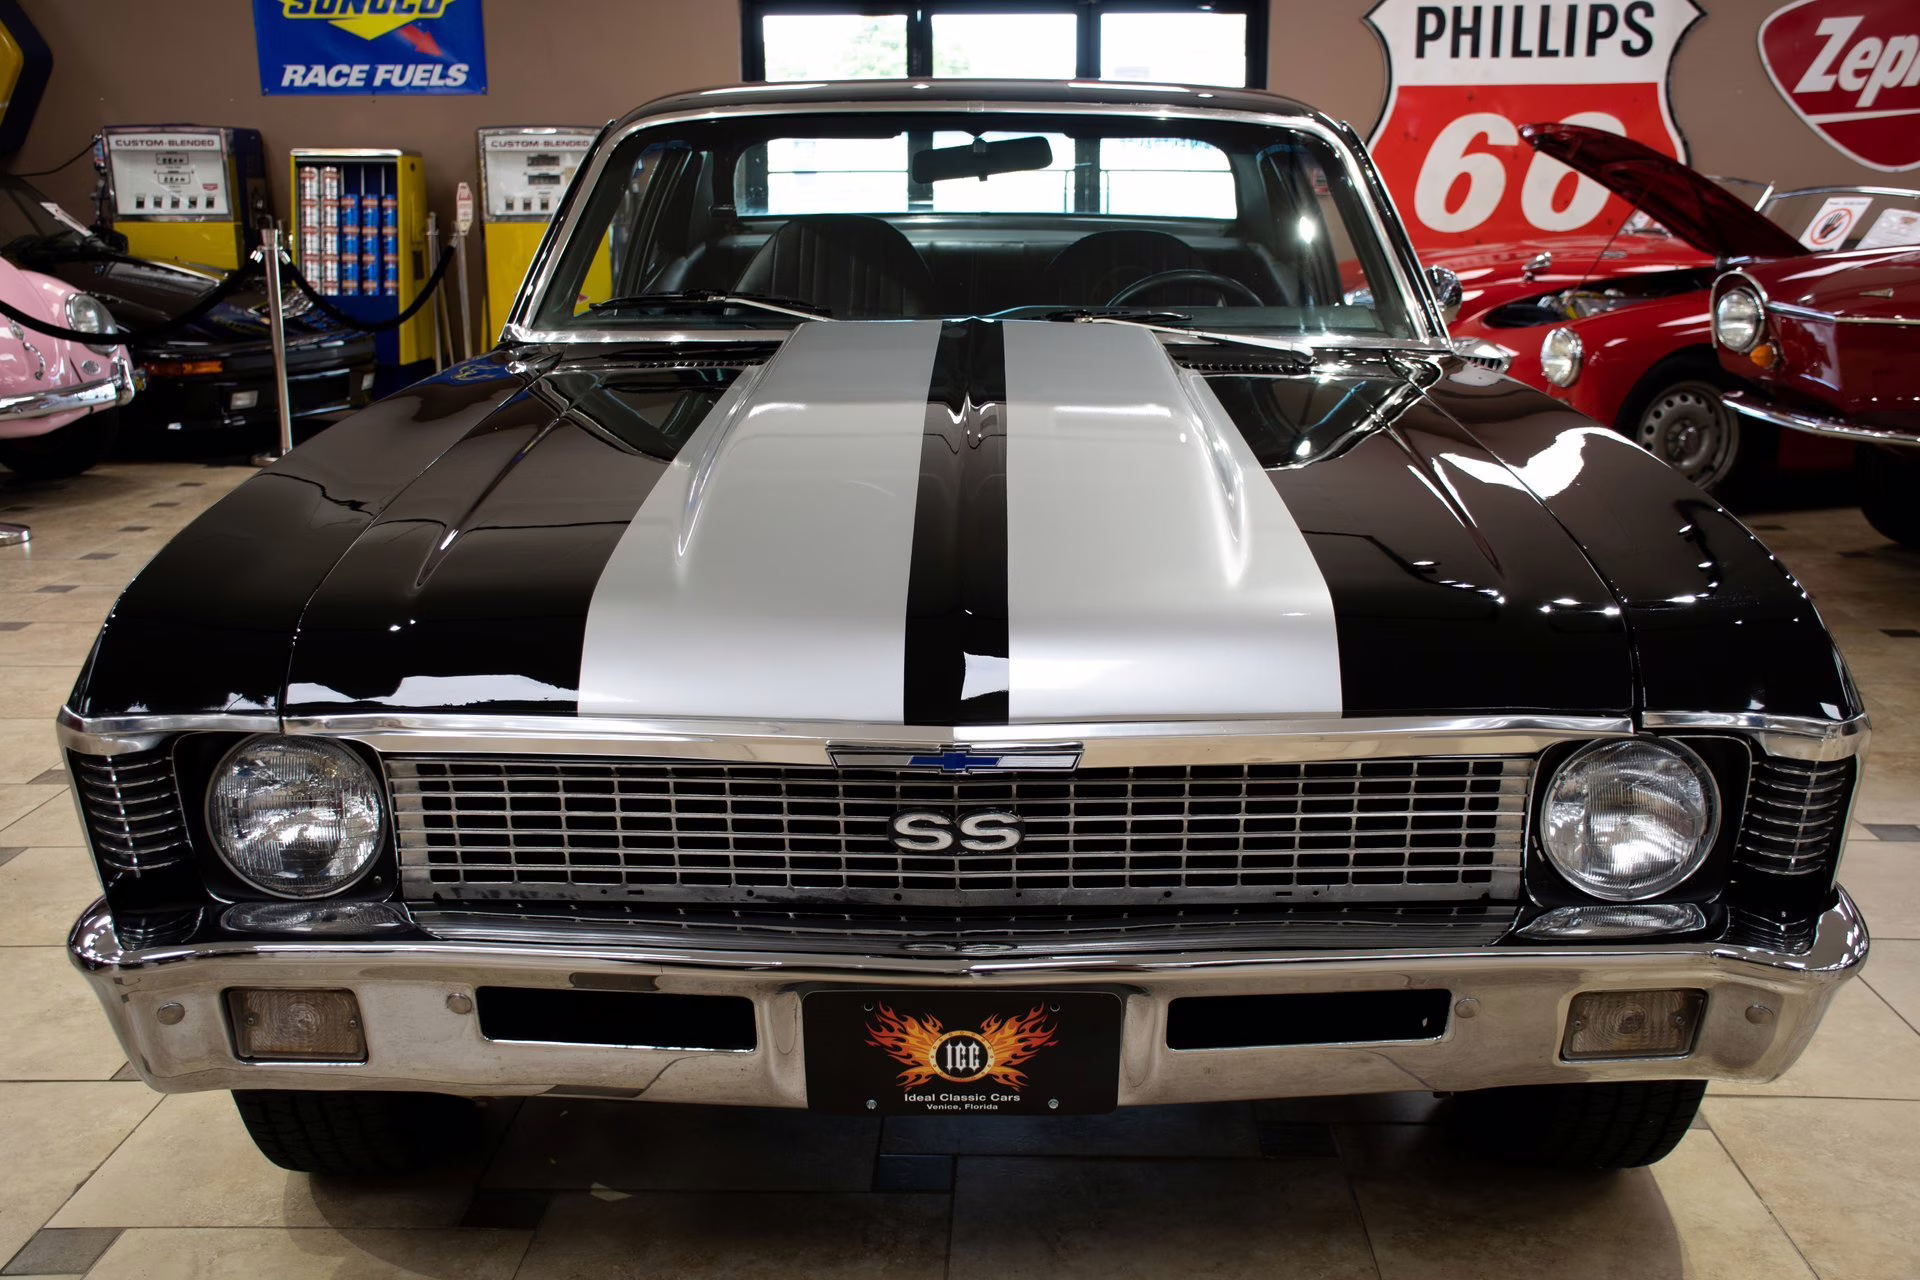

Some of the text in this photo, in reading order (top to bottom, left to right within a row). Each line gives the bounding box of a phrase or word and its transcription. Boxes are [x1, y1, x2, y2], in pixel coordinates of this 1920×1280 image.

[1415, 1, 1655, 59] PHILLIPS
[281, 64, 469, 87] RACE FUELS
[893, 812, 1022, 851] SS
[946, 1040, 980, 1073] ICC
[904, 1093, 1021, 1102] Ideal Classic Cars
[926, 1103, 962, 1111] Venice,
